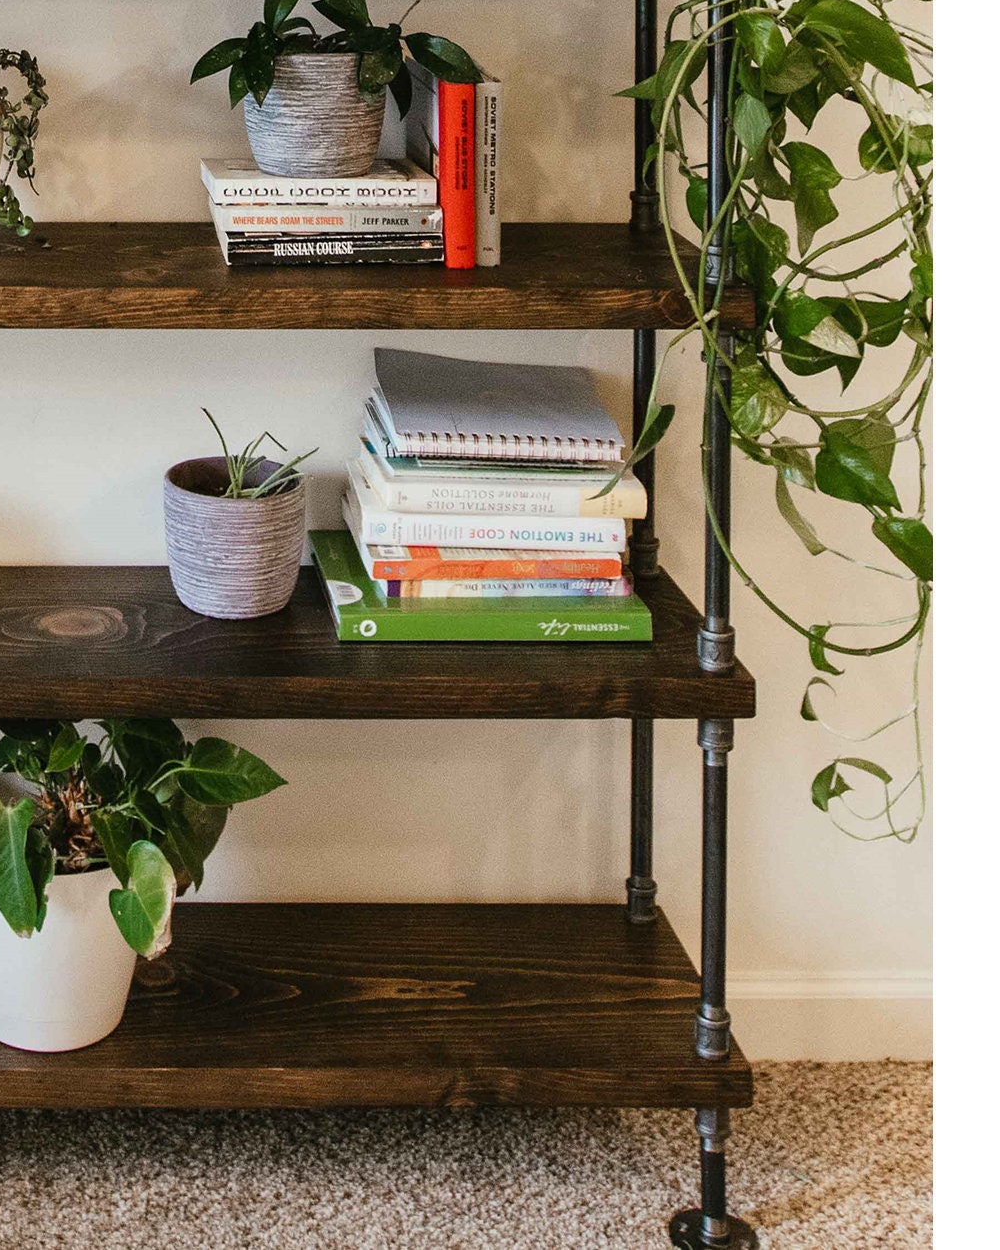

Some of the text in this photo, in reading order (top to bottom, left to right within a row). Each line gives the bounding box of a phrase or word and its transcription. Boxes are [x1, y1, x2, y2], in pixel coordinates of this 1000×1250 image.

[290, 188, 350, 197] COOK
[356, 188, 417, 197] BOOK
[232, 216, 344, 226] WHERE BEARS ROAM THE STREETS
[361, 218, 410, 226] JEFF PARKER
[274, 241, 354, 257] RUSSIAN COURSE
[432, 489, 551, 500] Hormone SOLUTION
[426, 501, 556, 513] THE ESSENTIAL OILS
[469, 528, 604, 542] THE EMOTION CODE
[571, 580, 616, 594] Feelings
[573, 624, 619, 632] ESSENTIAL
